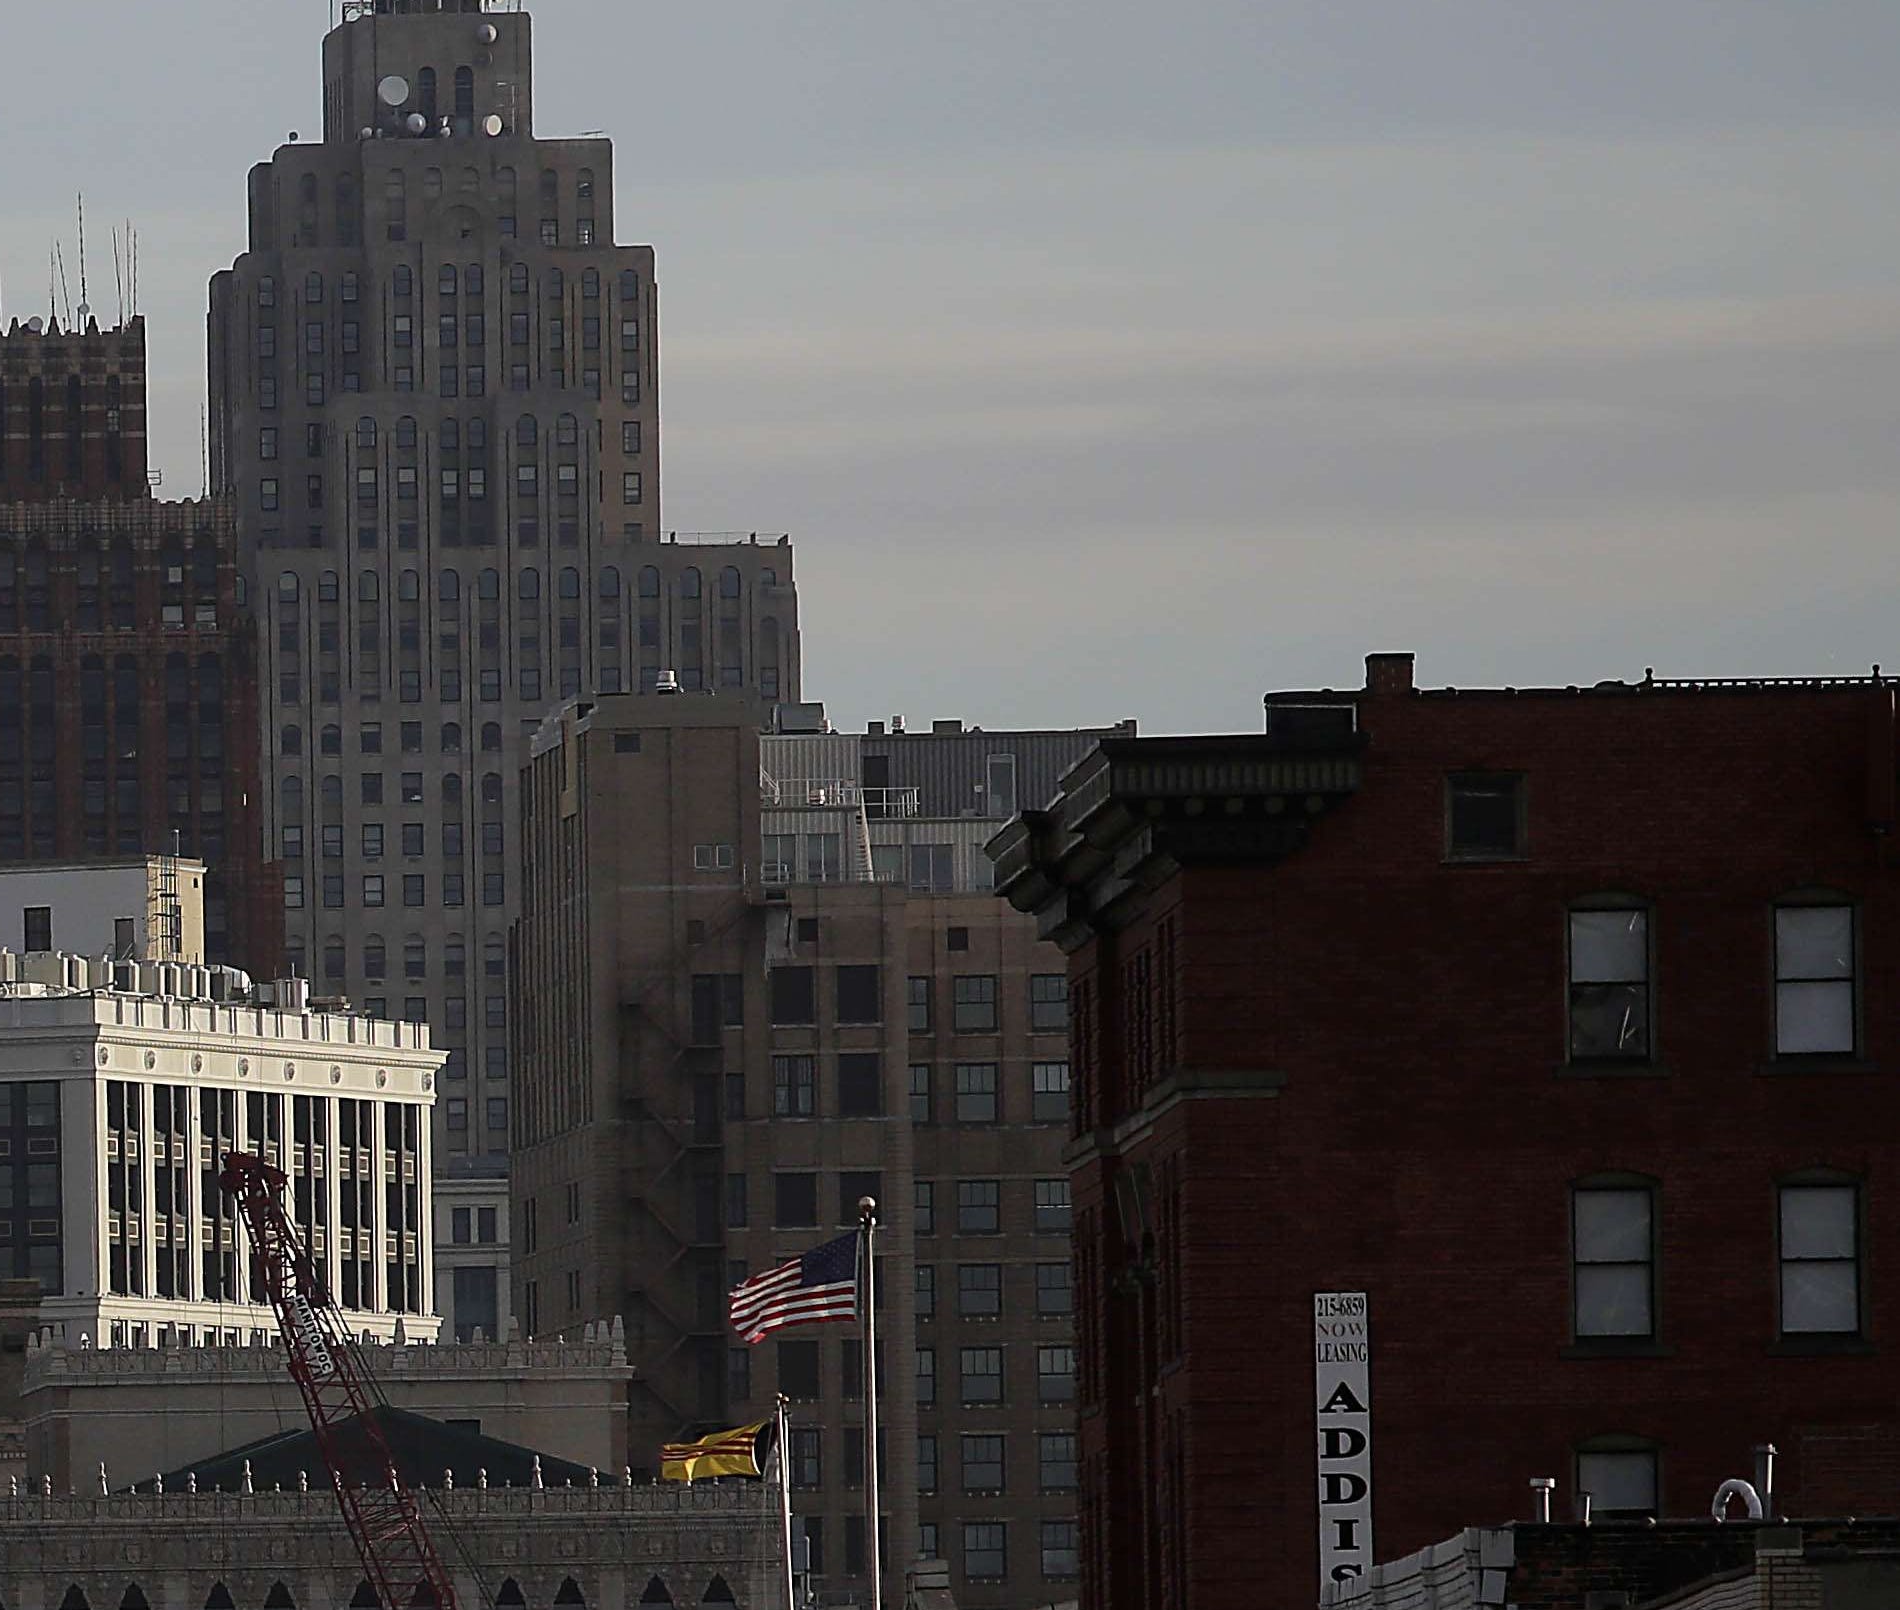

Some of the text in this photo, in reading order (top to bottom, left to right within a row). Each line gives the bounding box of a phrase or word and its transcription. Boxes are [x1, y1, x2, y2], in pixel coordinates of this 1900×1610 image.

[1316, 1297, 1366, 1317] 215-6859
[1317, 1323, 1366, 1337] NOW
[1317, 1342, 1367, 1364] LEASING
